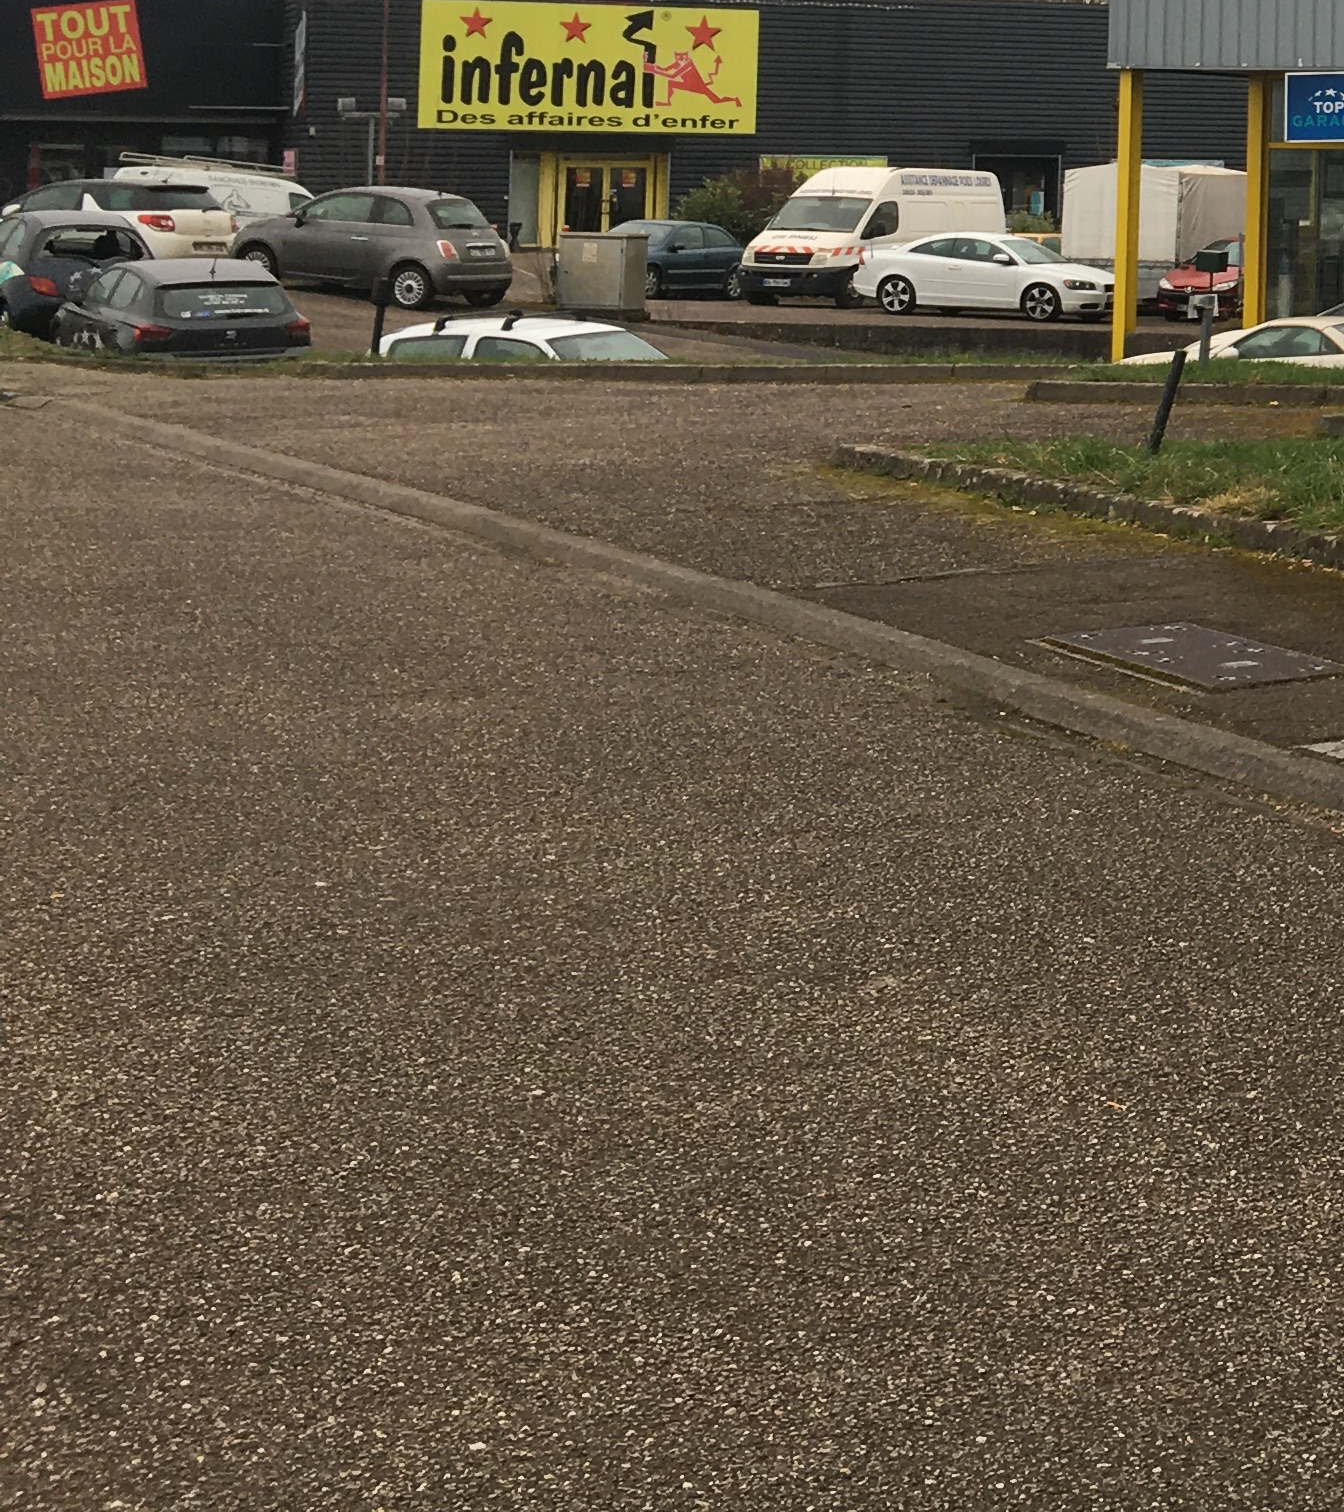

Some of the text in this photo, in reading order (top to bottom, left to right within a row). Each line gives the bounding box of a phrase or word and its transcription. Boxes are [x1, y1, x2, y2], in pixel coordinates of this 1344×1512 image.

[35, 5, 131, 41] TOUT
[41, 34, 137, 61] POUR LA
[44, 53, 140, 92] MAISON
[436, 110, 740, 129] Des affaires d'enfer
[1313, 102, 1344, 114] TOP
